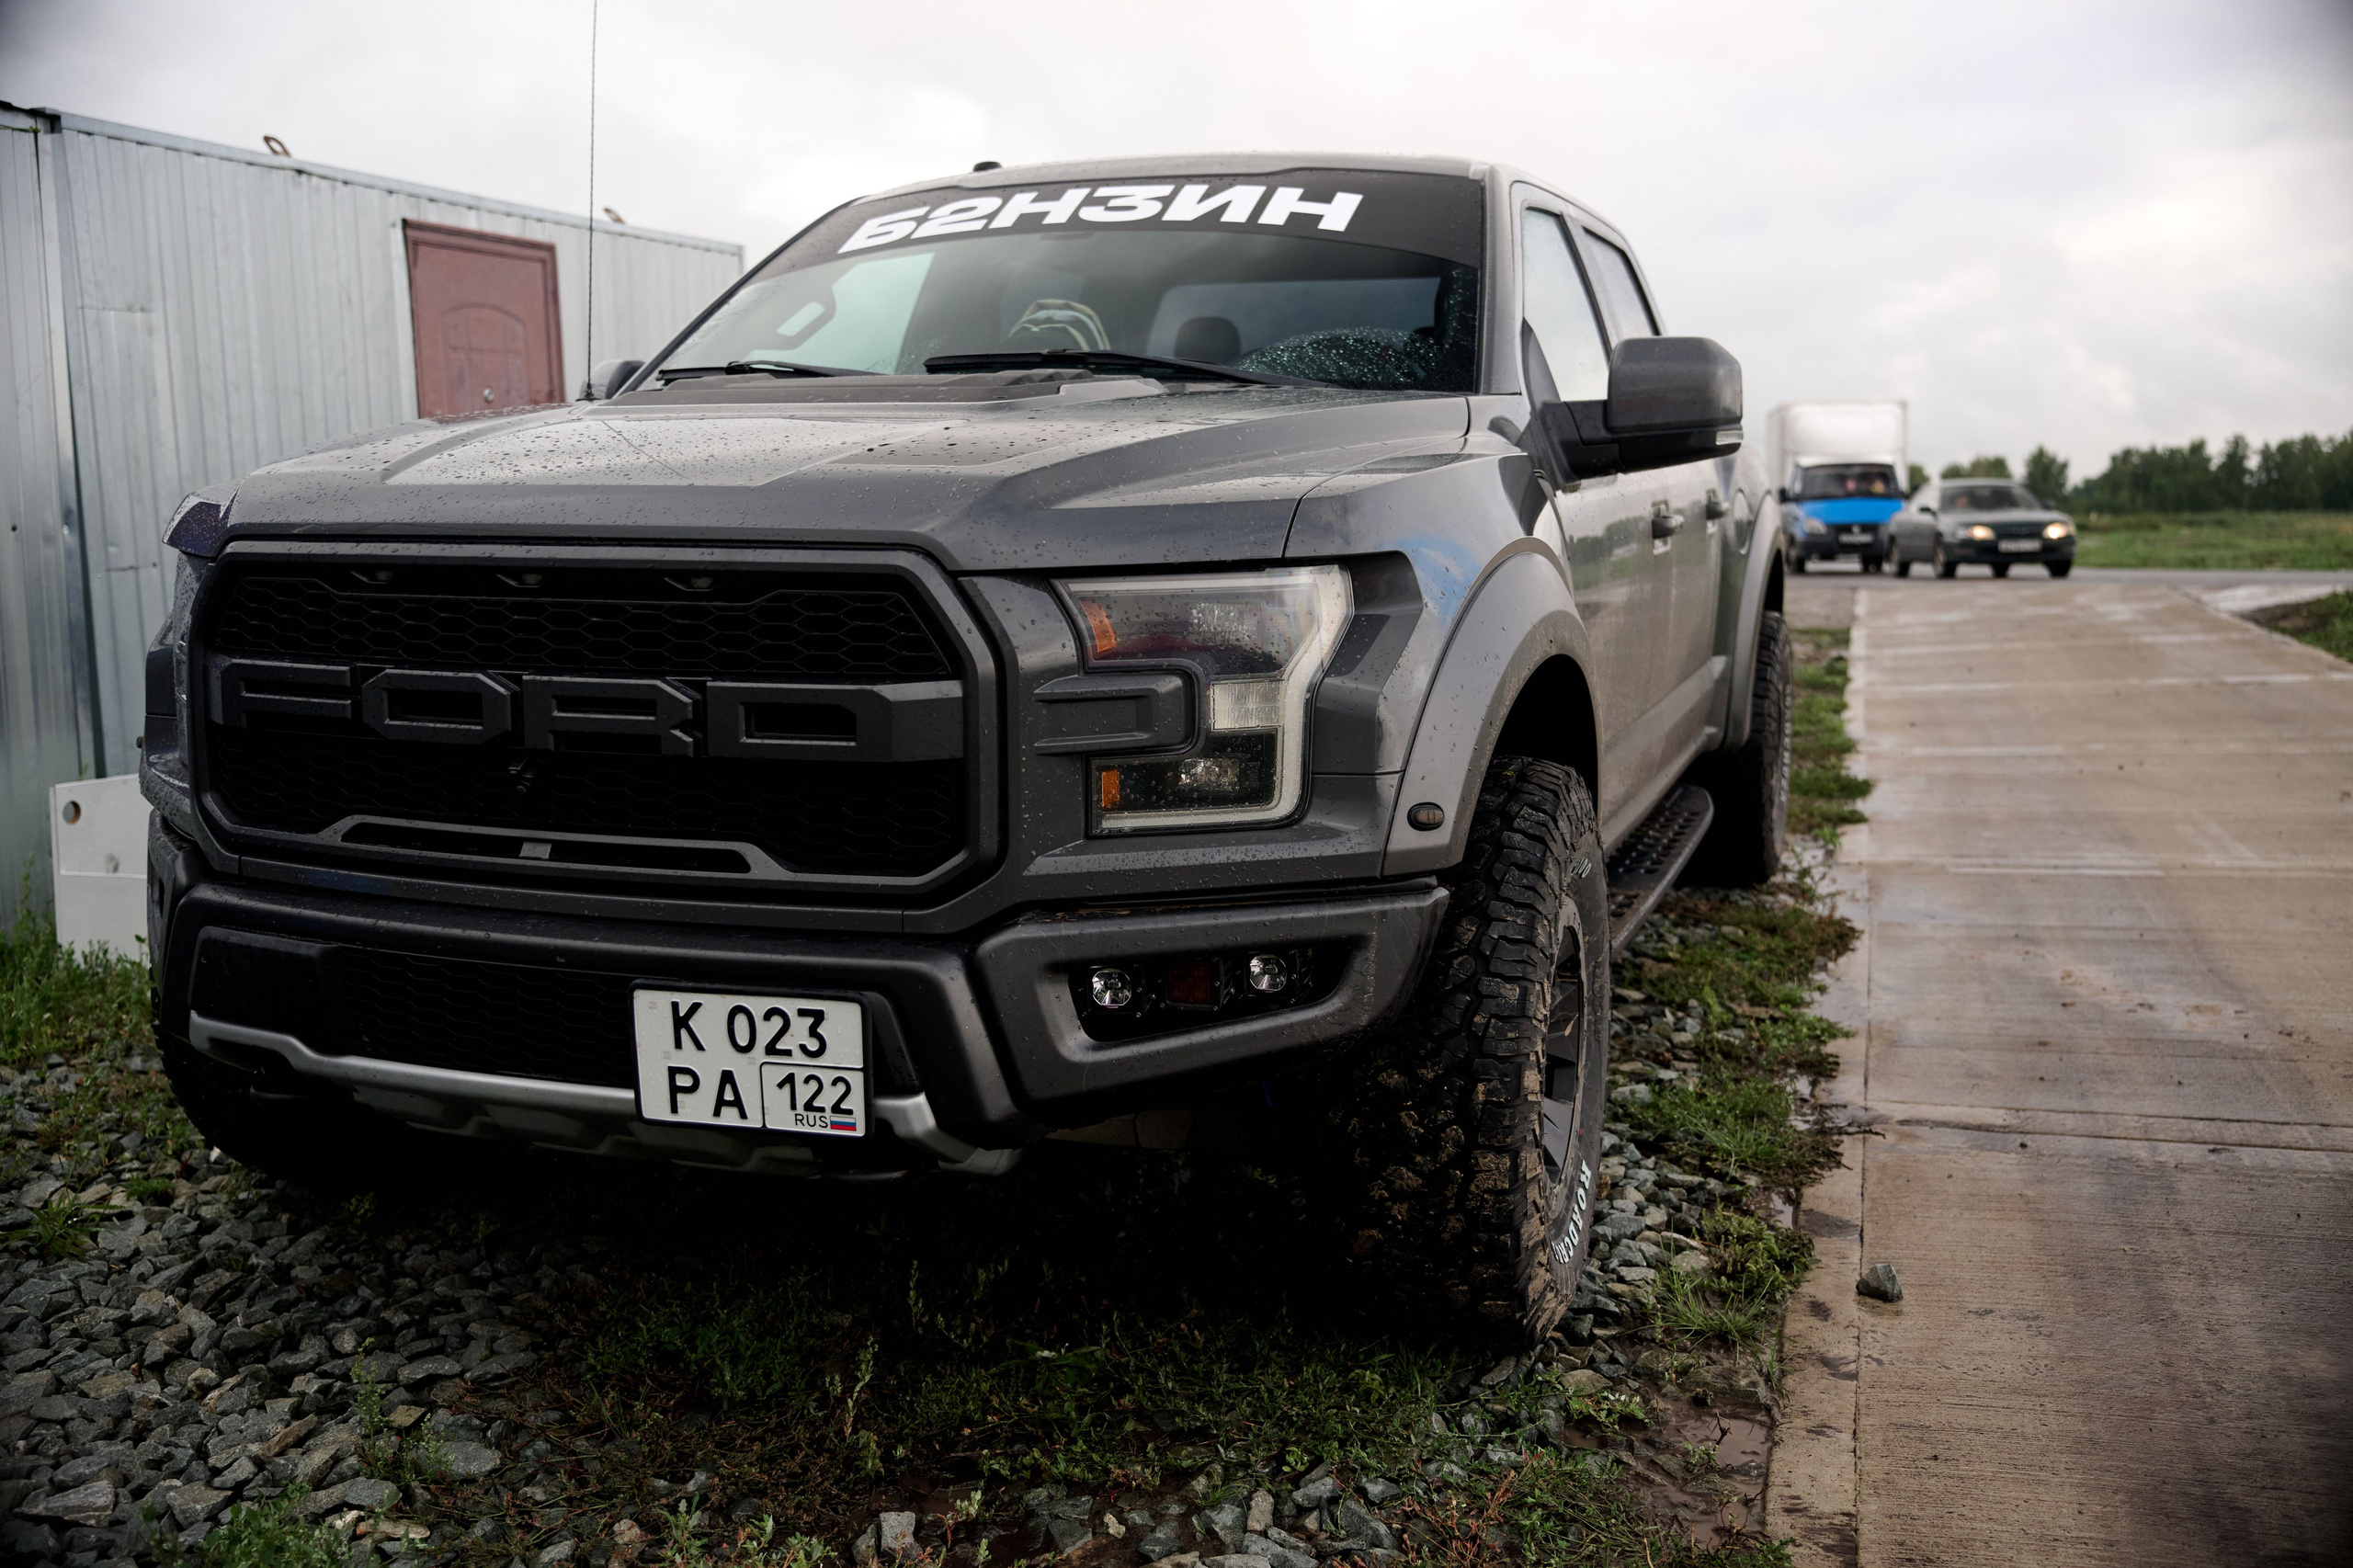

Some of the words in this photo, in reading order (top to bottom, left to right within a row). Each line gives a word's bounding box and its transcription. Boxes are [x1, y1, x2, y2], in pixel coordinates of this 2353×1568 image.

[210, 658, 963, 763] FORD
[671, 1000, 706, 1051] К
[727, 1004, 827, 1058] 023
[667, 1065, 748, 1119] РА
[777, 1072, 854, 1115] 122
[794, 1113, 828, 1129] RUS
